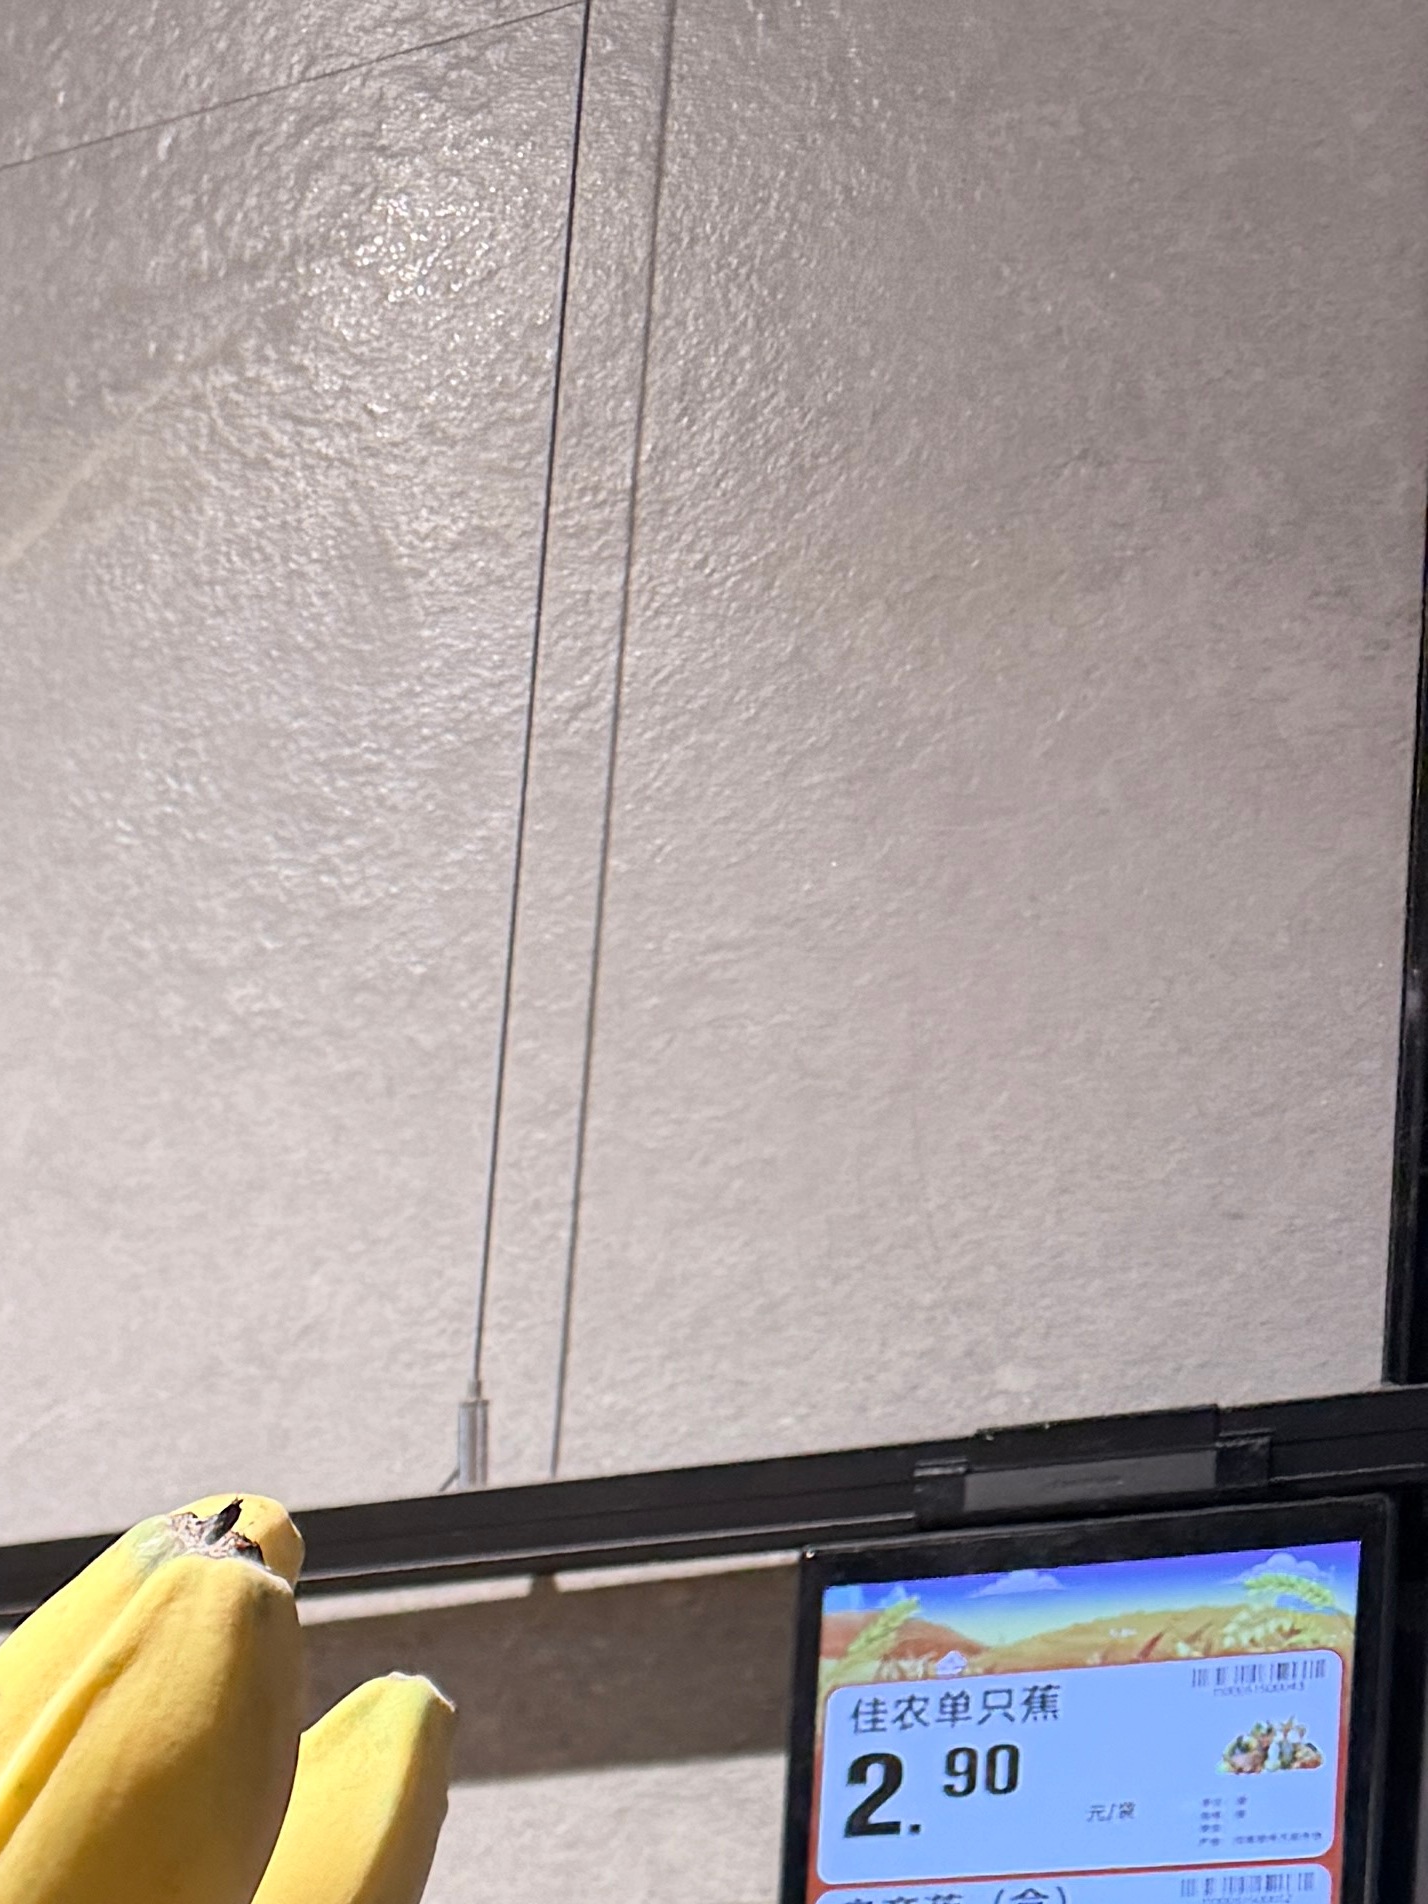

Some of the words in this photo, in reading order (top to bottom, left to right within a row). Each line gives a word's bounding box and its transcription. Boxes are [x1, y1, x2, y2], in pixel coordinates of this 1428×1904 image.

[850, 1684, 1063, 1735] 佳农单只蕉
[943, 1744, 1021, 1798] 90
